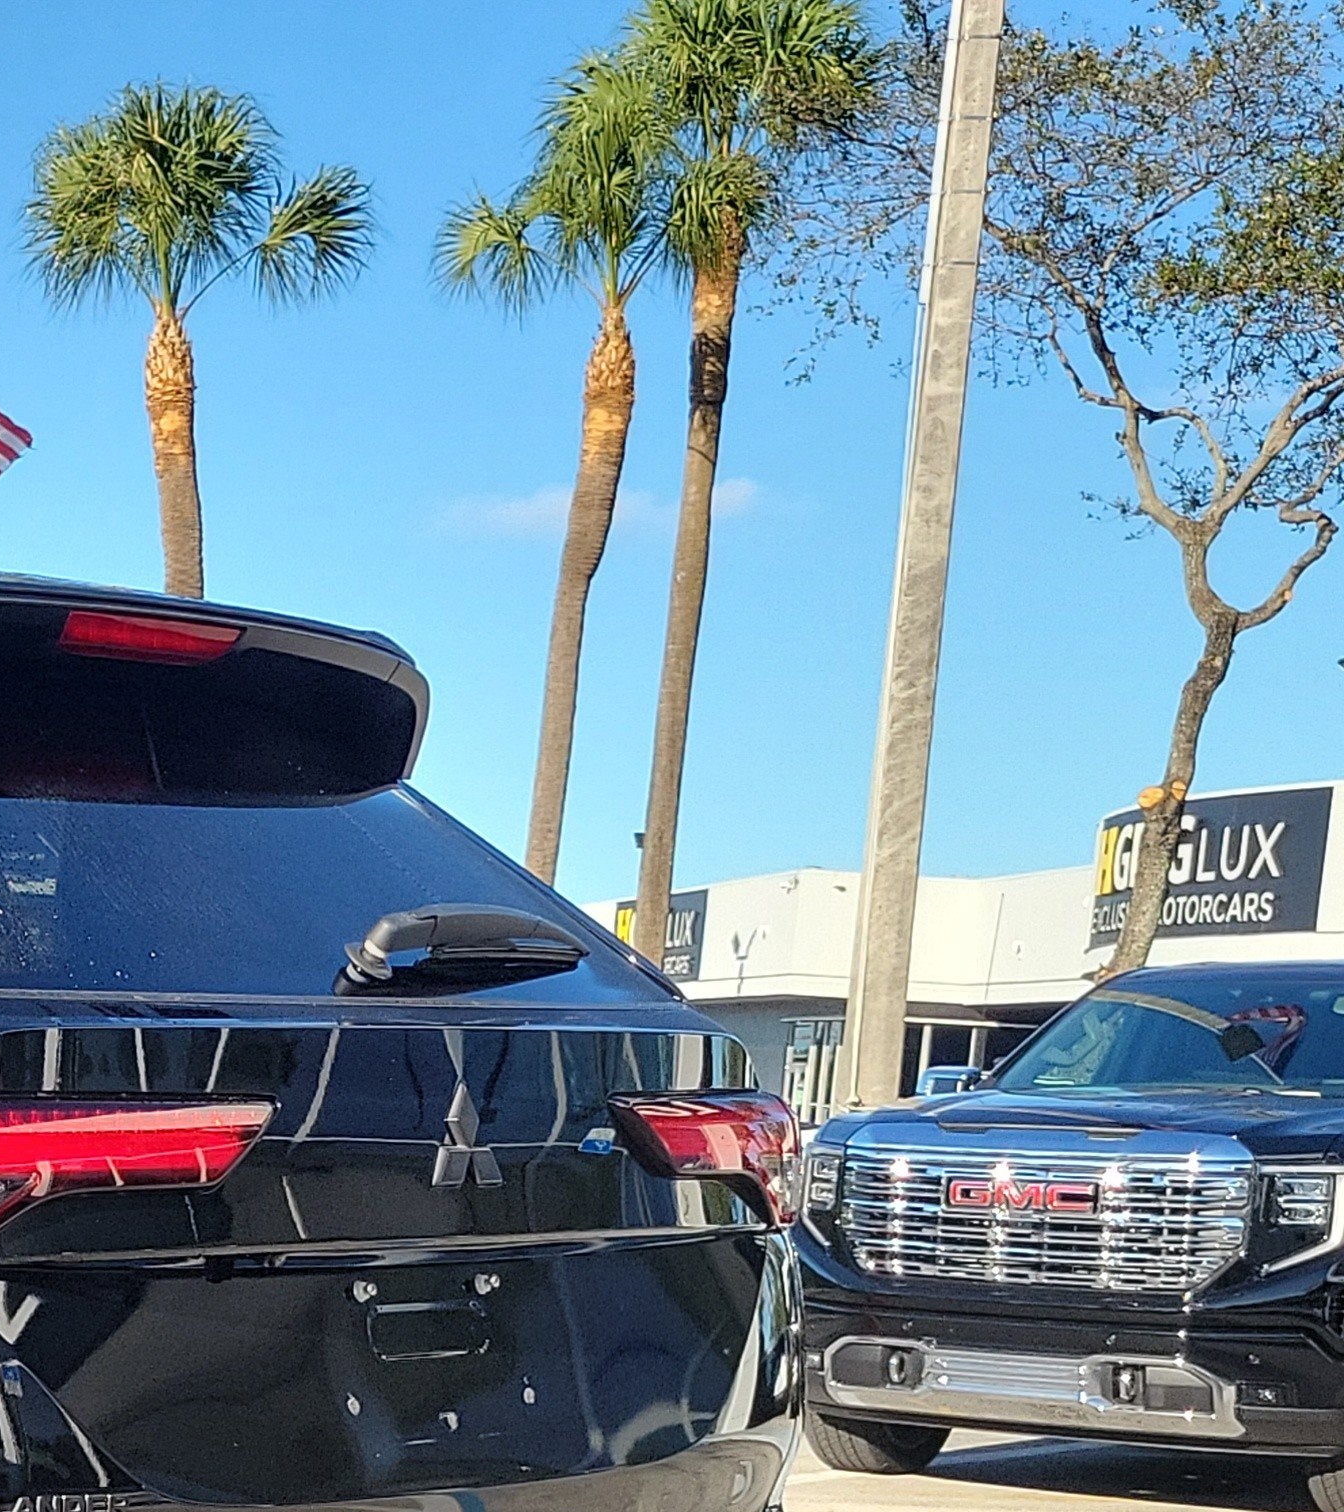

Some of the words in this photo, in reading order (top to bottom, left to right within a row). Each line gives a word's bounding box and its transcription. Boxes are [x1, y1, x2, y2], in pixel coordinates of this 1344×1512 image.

[1095, 815, 1286, 896] HGGLUX
[1158, 892, 1275, 925] OTORCARS
[948, 1180, 1095, 1212] GMC
